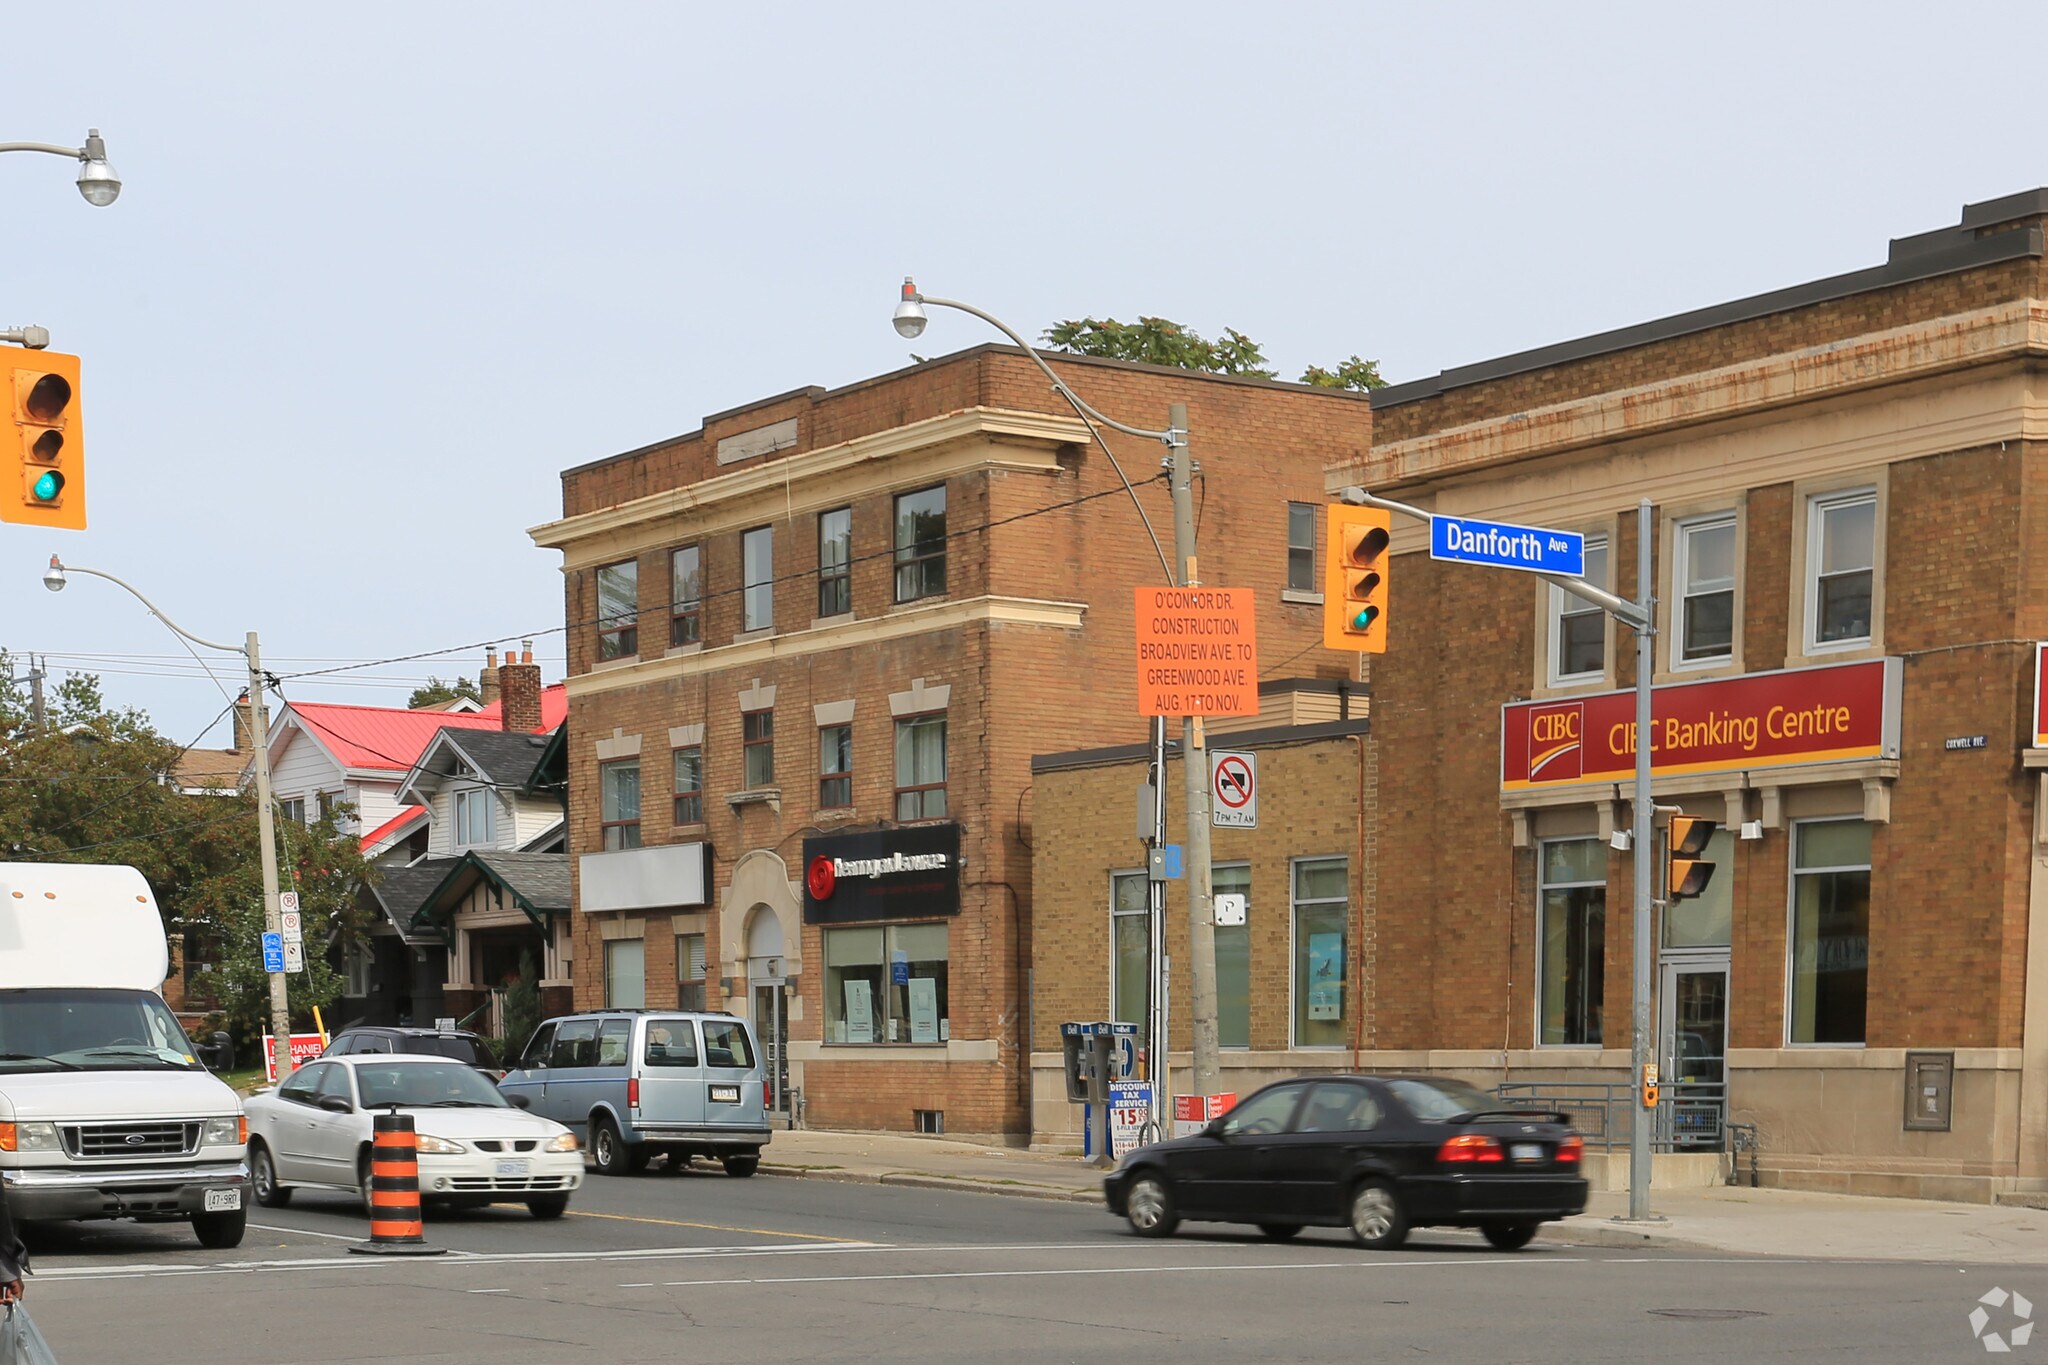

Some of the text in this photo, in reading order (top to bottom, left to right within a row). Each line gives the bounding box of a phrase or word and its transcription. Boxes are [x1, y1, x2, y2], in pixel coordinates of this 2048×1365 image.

[1447, 522, 1568, 562] Danforth Ave
[1155, 592, 1234, 610] O'CONNOR DR.
[1152, 618, 1239, 635] CONSTRUCTION
[1141, 643, 1252, 660] BROADVIEW AVE. TO
[1147, 669, 1248, 686] GREENWOOD AVE.
[1155, 694, 1242, 711] AUG. 17 TO NOV.
[1533, 711, 1579, 743] CIBC
[1665, 710, 1758, 751] Banking
[1766, 703, 1850, 740] Centre
[1068, 1025, 1077, 1034] Bell
[1099, 1025, 1108, 1034] Bell
[1115, 1099, 1147, 1107] SERVICE
[1122, 1091, 1139, 1099] TAX
